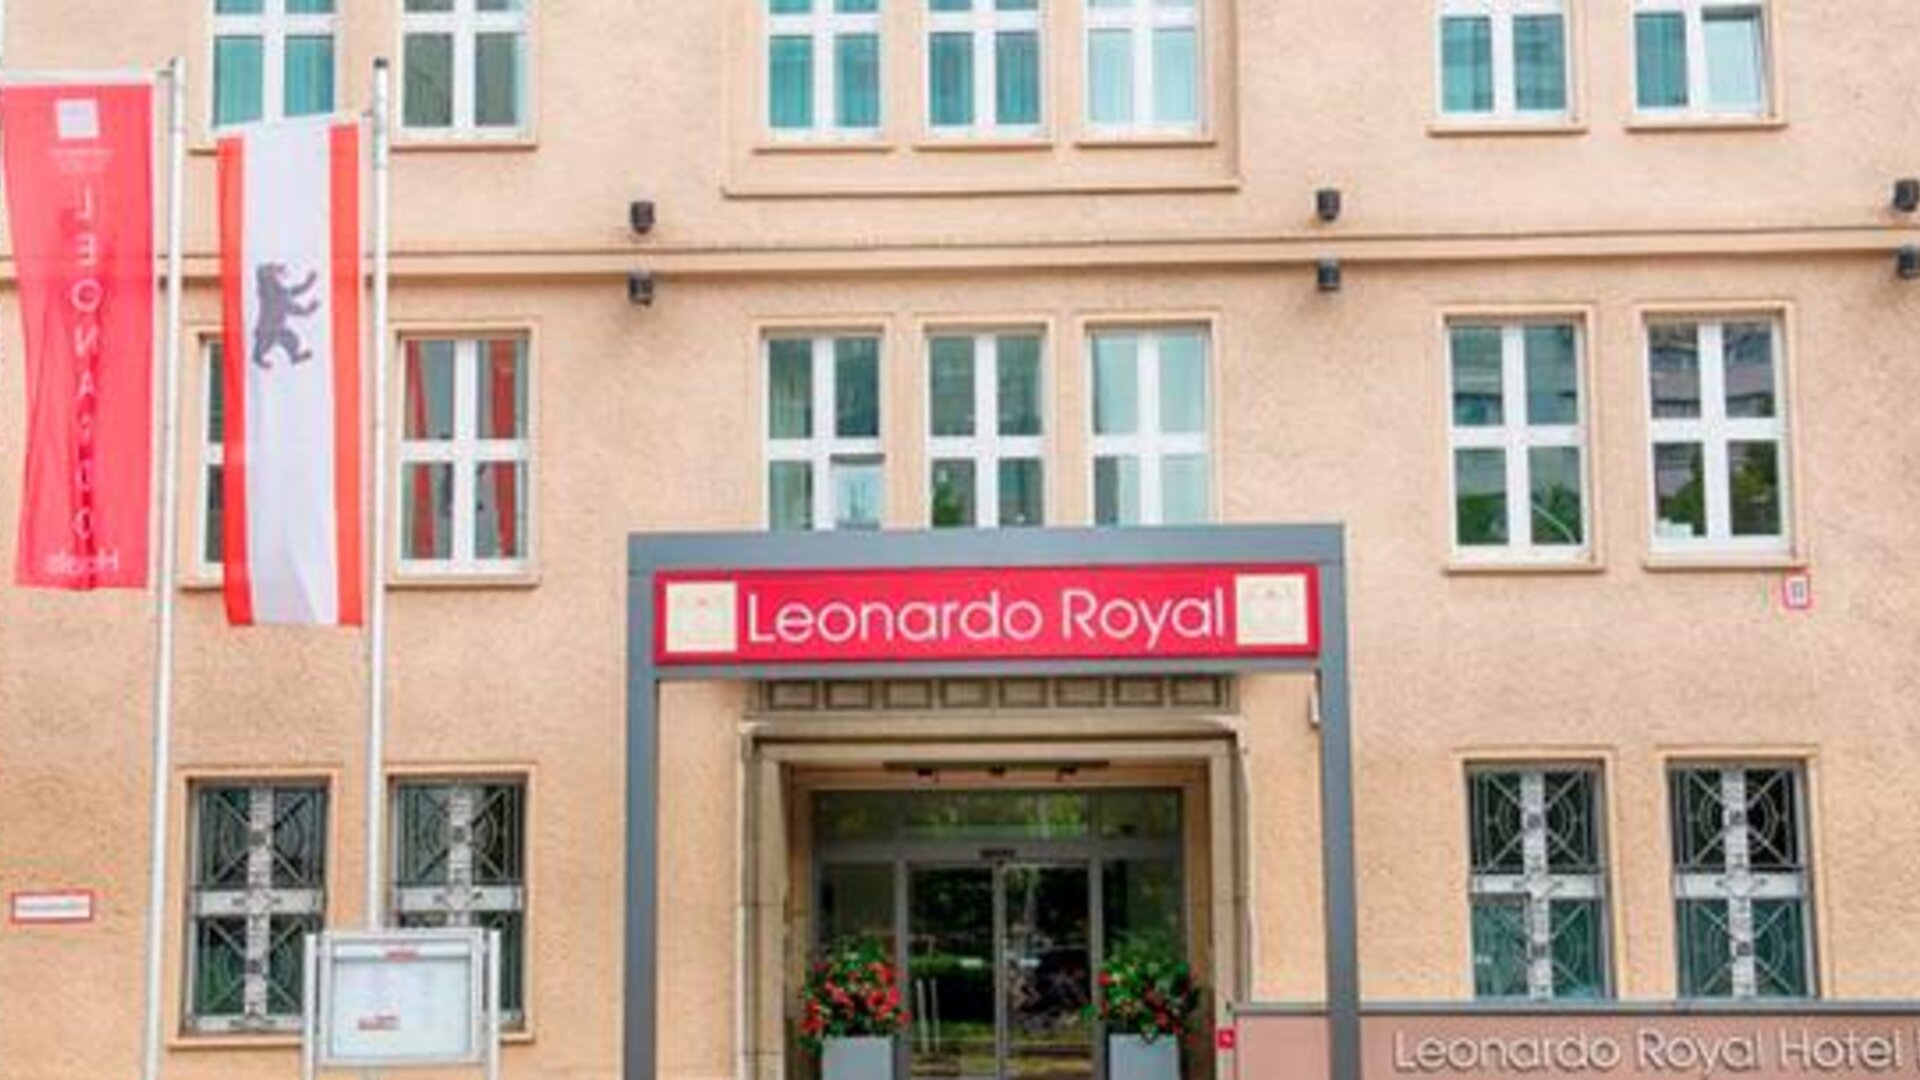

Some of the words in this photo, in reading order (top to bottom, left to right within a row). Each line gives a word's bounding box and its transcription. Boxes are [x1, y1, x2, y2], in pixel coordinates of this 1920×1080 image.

[748, 589, 1043, 643] Leonardo
[1061, 587, 1225, 650] Royal
[1393, 1027, 1621, 1072] Leonardo
[1637, 1028, 1762, 1077] Royal
[1779, 1027, 1903, 1071] Hotel
